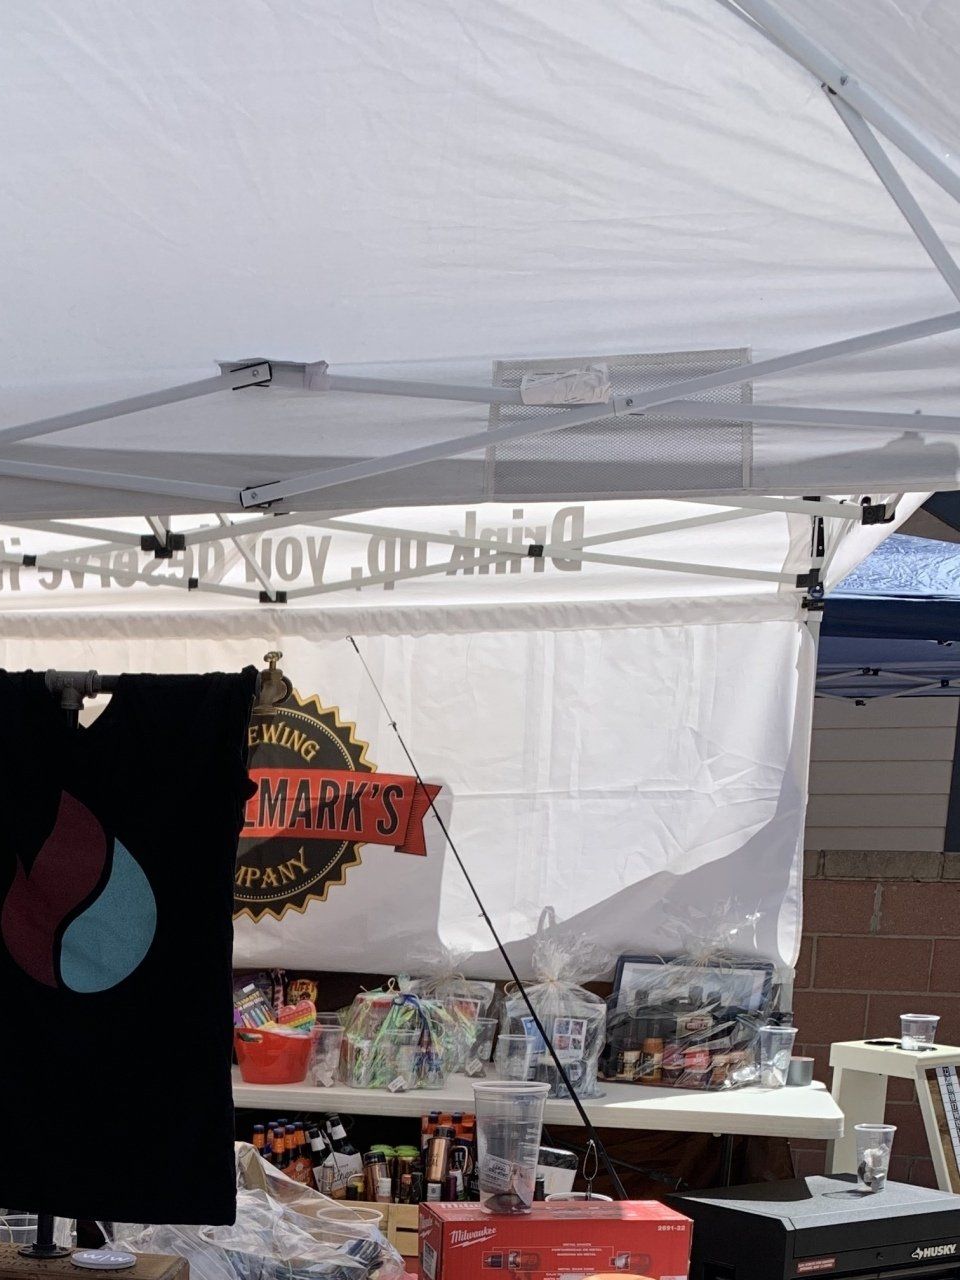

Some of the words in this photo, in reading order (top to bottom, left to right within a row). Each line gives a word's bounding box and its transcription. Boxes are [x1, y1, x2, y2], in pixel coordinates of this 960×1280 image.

[247, 721, 320, 762] EWING
[234, 846, 311, 889] MPANY
[449, 1226, 497, 1245] Milwaukee
[922, 1243, 957, 1258] HUSKY
